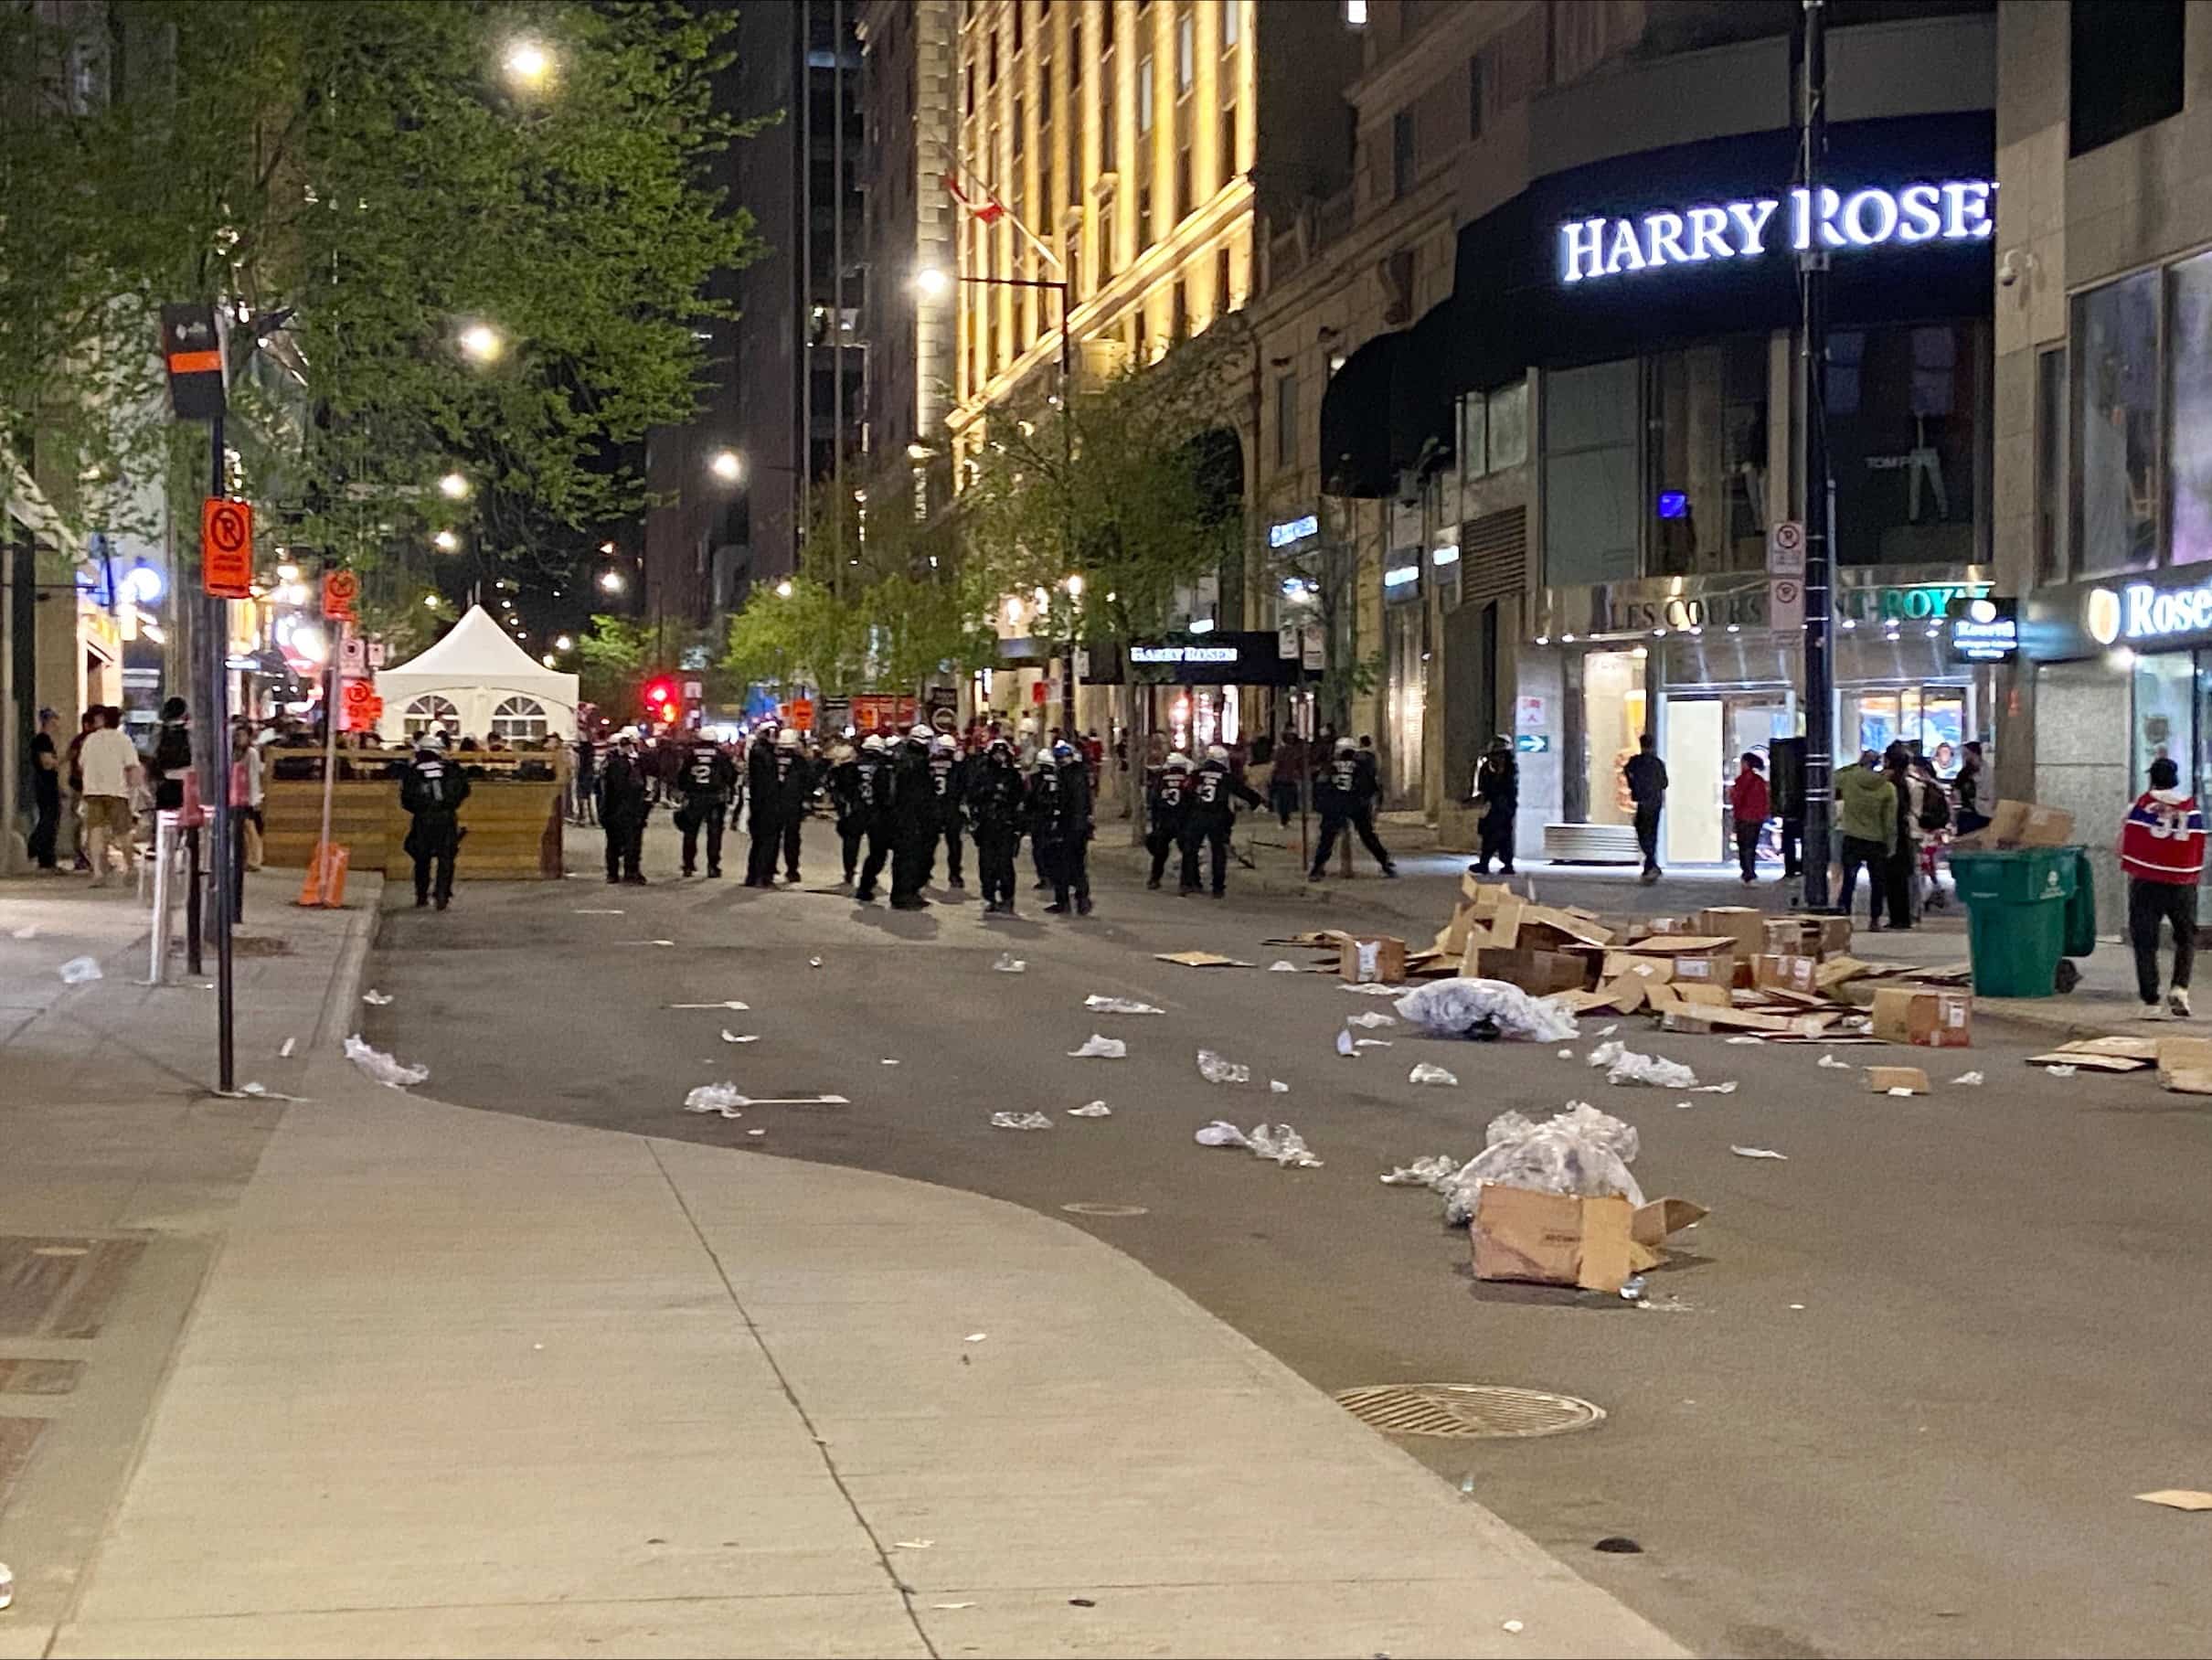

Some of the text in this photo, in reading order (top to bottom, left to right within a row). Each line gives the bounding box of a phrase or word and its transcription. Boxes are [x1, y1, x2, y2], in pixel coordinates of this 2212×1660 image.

[1563, 182, 2000, 282] HARRY ROSE
[1611, 601, 1655, 630] LES
[1665, 596, 1762, 629] COURS
[1185, 647, 1237, 661] ROSEN
